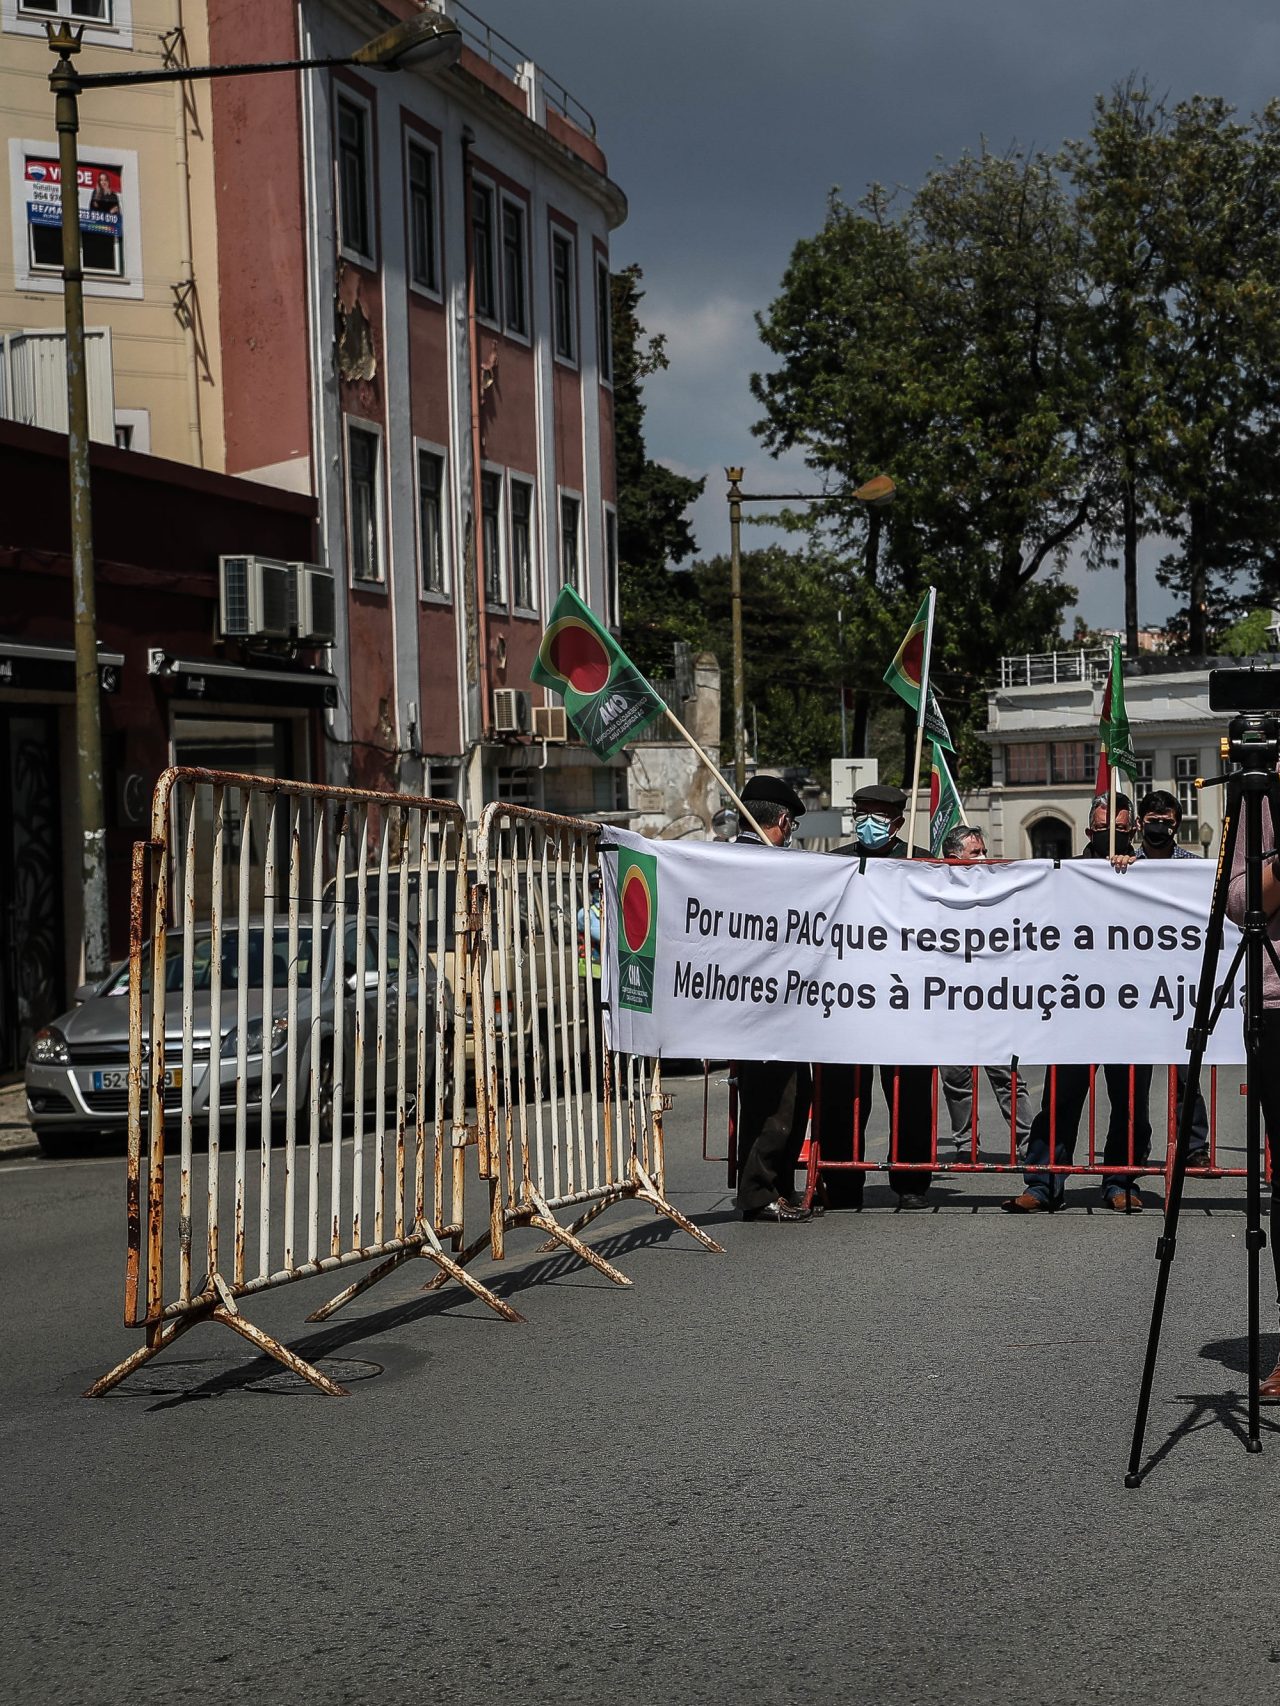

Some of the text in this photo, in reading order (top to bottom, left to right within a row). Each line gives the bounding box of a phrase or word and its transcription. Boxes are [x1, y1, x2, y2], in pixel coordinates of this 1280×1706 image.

[49, 166, 92, 185] VDE
[685, 897, 1225, 963] Por uma PAC que respeite a noss
[673, 960, 779, 1004] Melhores
[783, 969, 876, 1019] Preços
[889, 973, 909, 1010] à
[923, 973, 1106, 1021] Produção
[1118, 983, 1139, 1009] e
